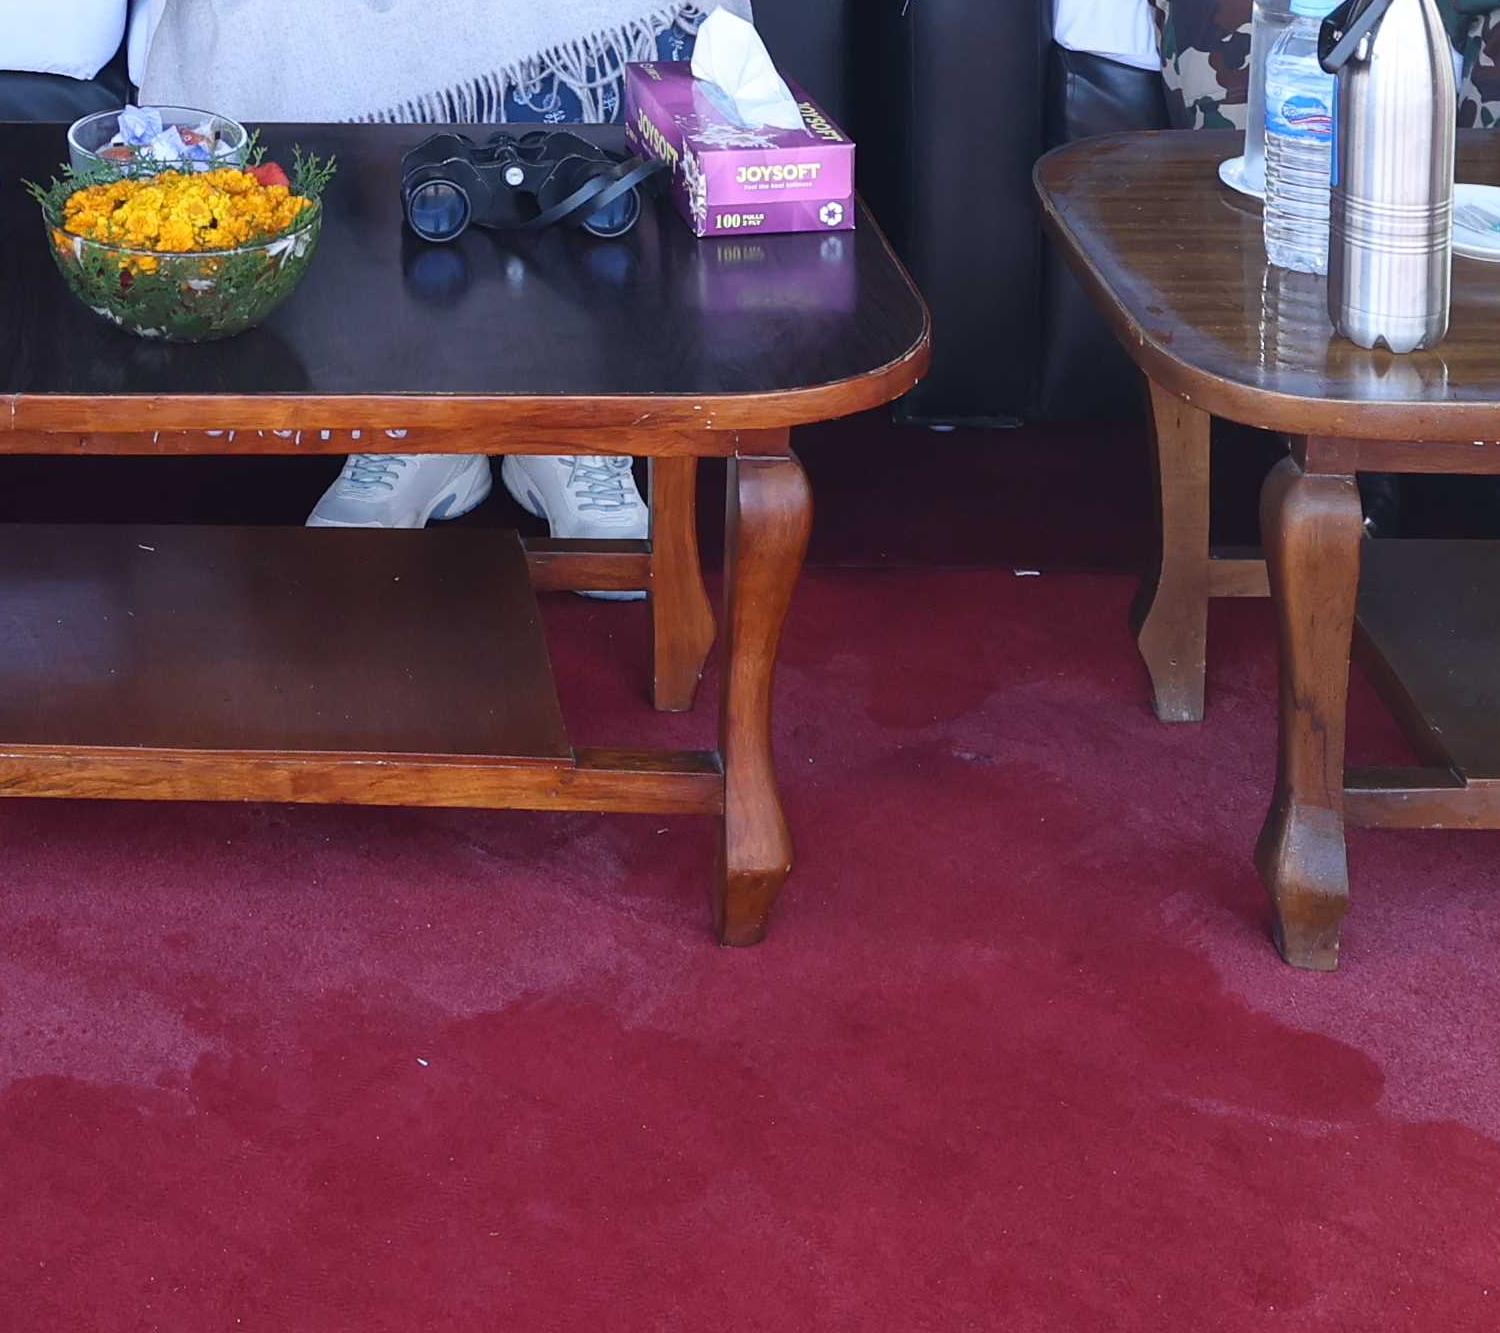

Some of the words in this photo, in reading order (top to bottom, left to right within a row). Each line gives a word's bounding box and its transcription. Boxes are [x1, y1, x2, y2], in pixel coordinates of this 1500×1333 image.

[637, 107, 679, 175] JOYSOFT
[735, 163, 821, 183] JOYSOFT
[715, 214, 741, 229] 100
[742, 213, 765, 221] PULLS
